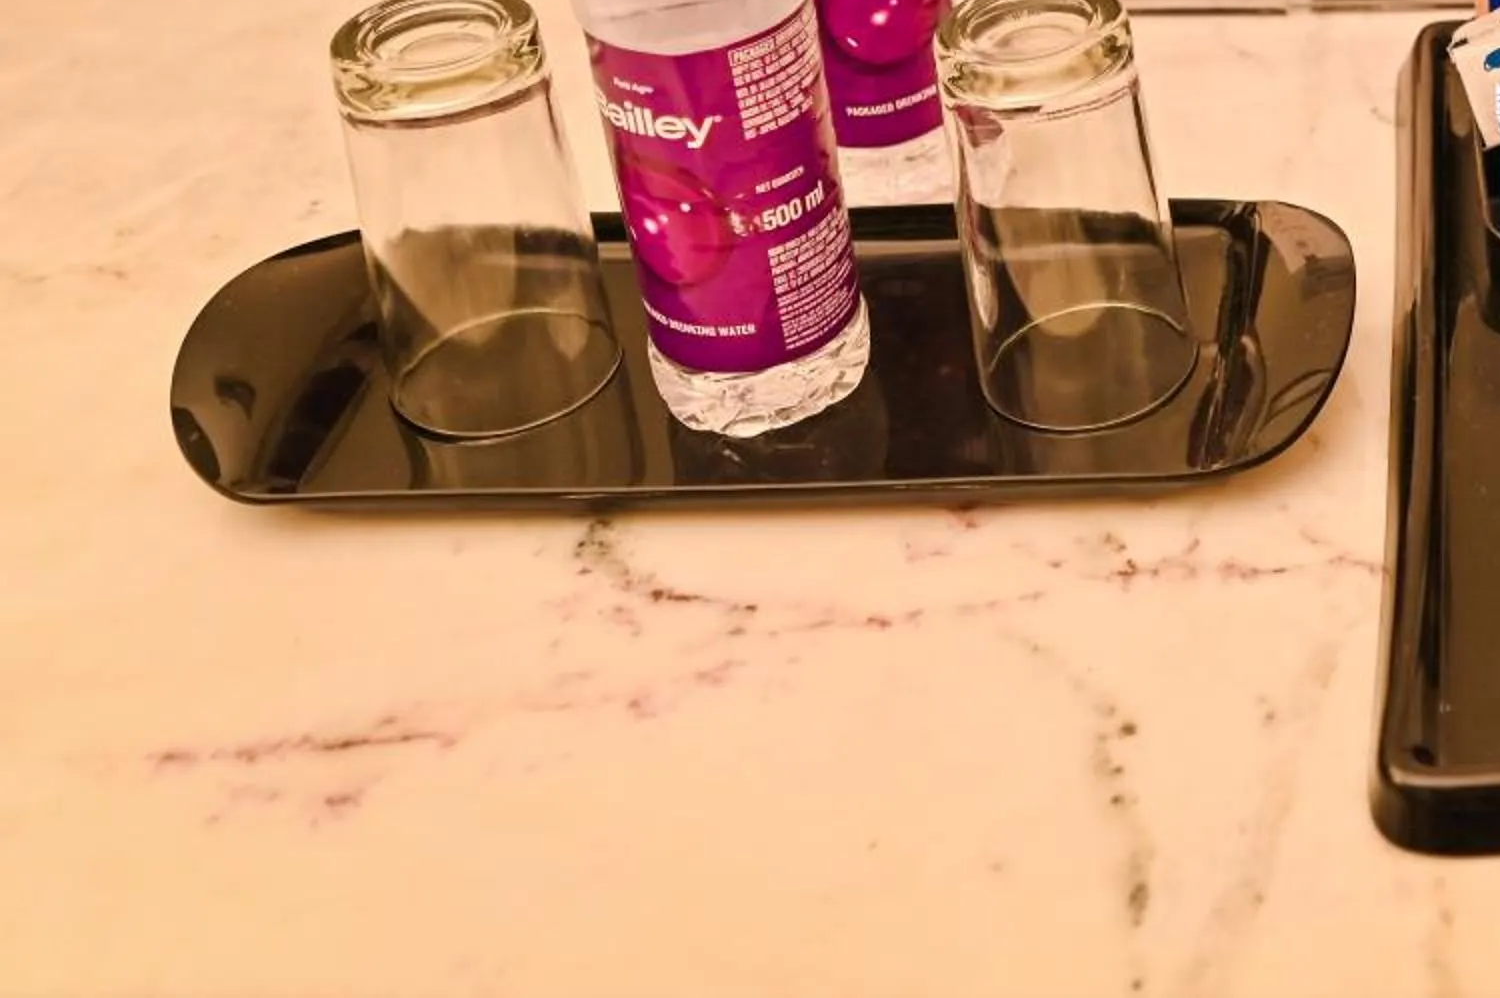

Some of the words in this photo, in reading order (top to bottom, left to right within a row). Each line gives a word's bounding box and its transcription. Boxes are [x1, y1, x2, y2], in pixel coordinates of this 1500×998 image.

[762, 196, 803, 232] 500
[805, 179, 825, 212] ml
[718, 323, 757, 337] WATER
